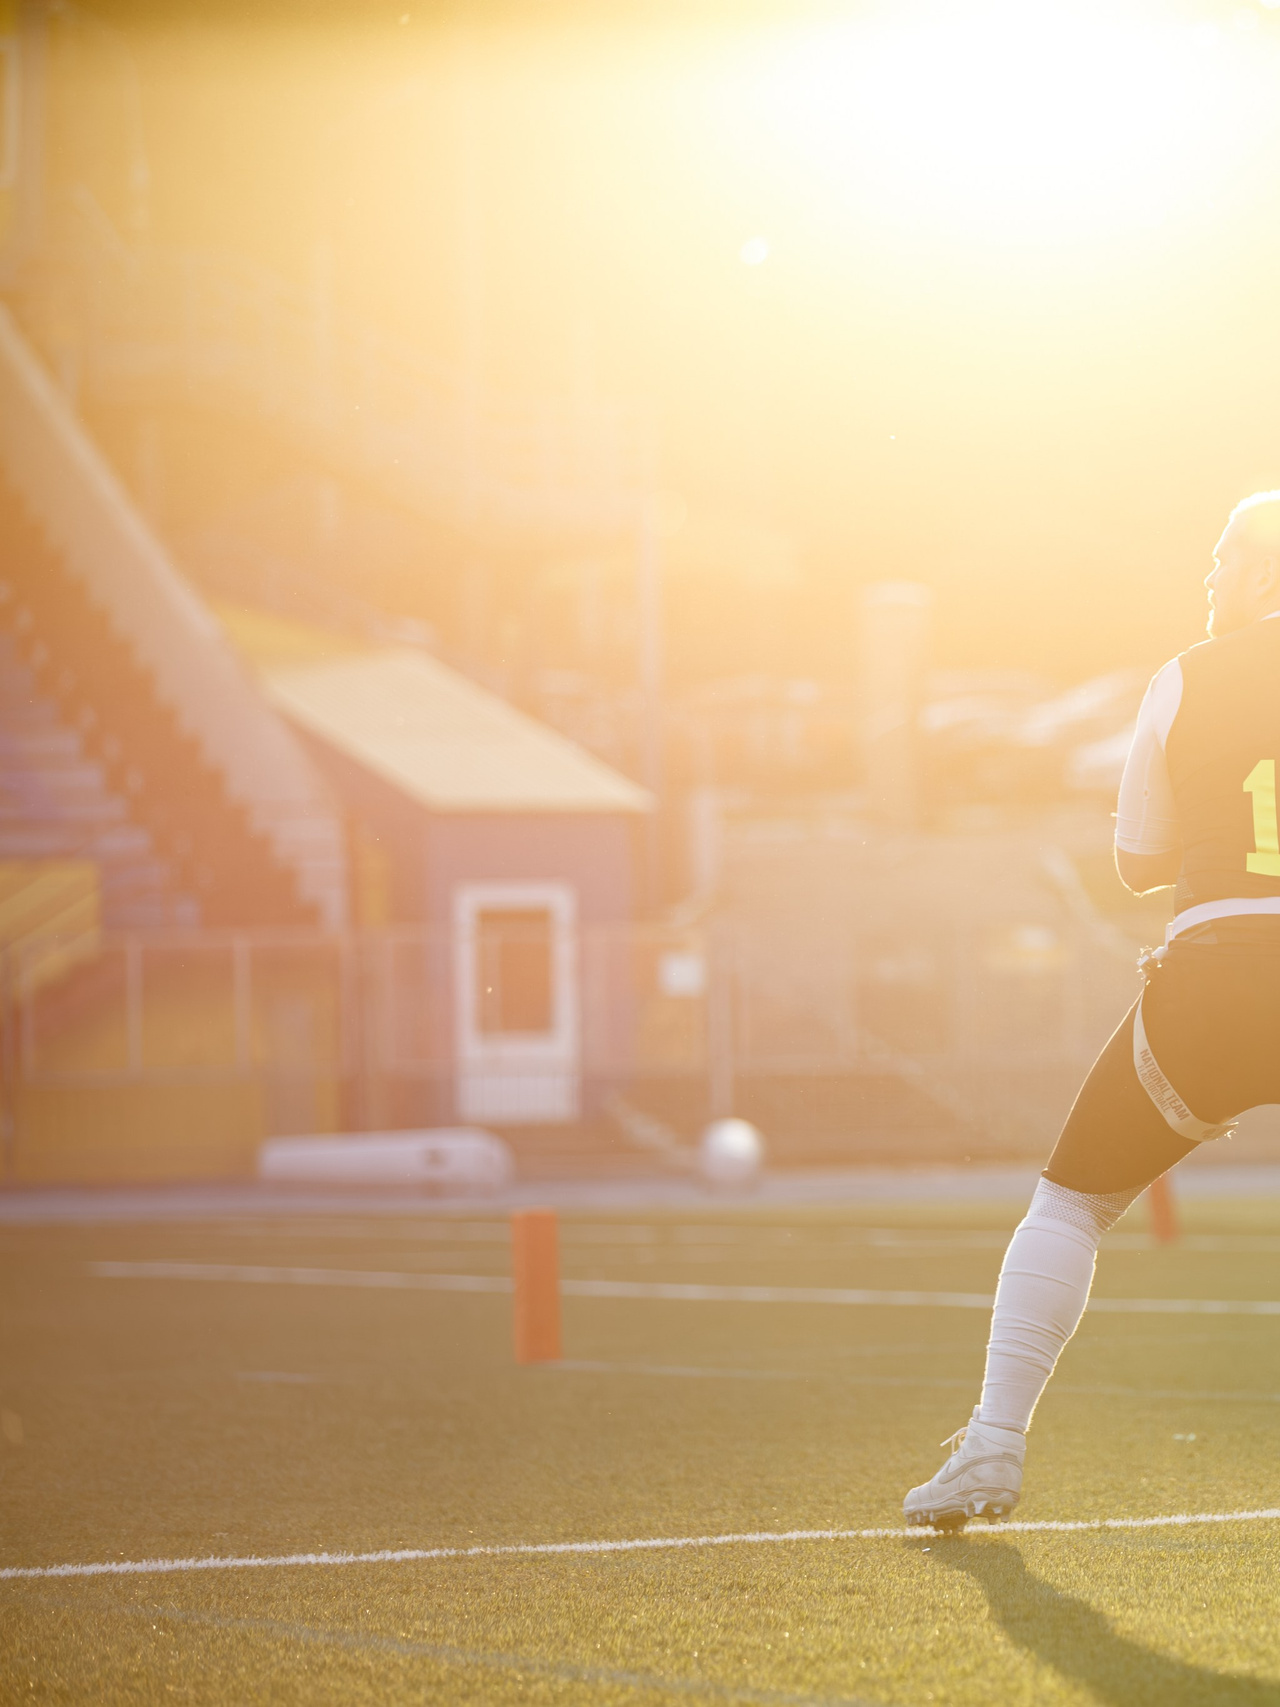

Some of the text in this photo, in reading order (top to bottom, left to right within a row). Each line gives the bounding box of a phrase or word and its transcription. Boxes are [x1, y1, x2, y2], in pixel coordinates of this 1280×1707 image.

[1137, 1065, 1170, 1113] FLAG FOOTBALL
[1140, 1048, 1190, 1121] NATIONAL TEAM
